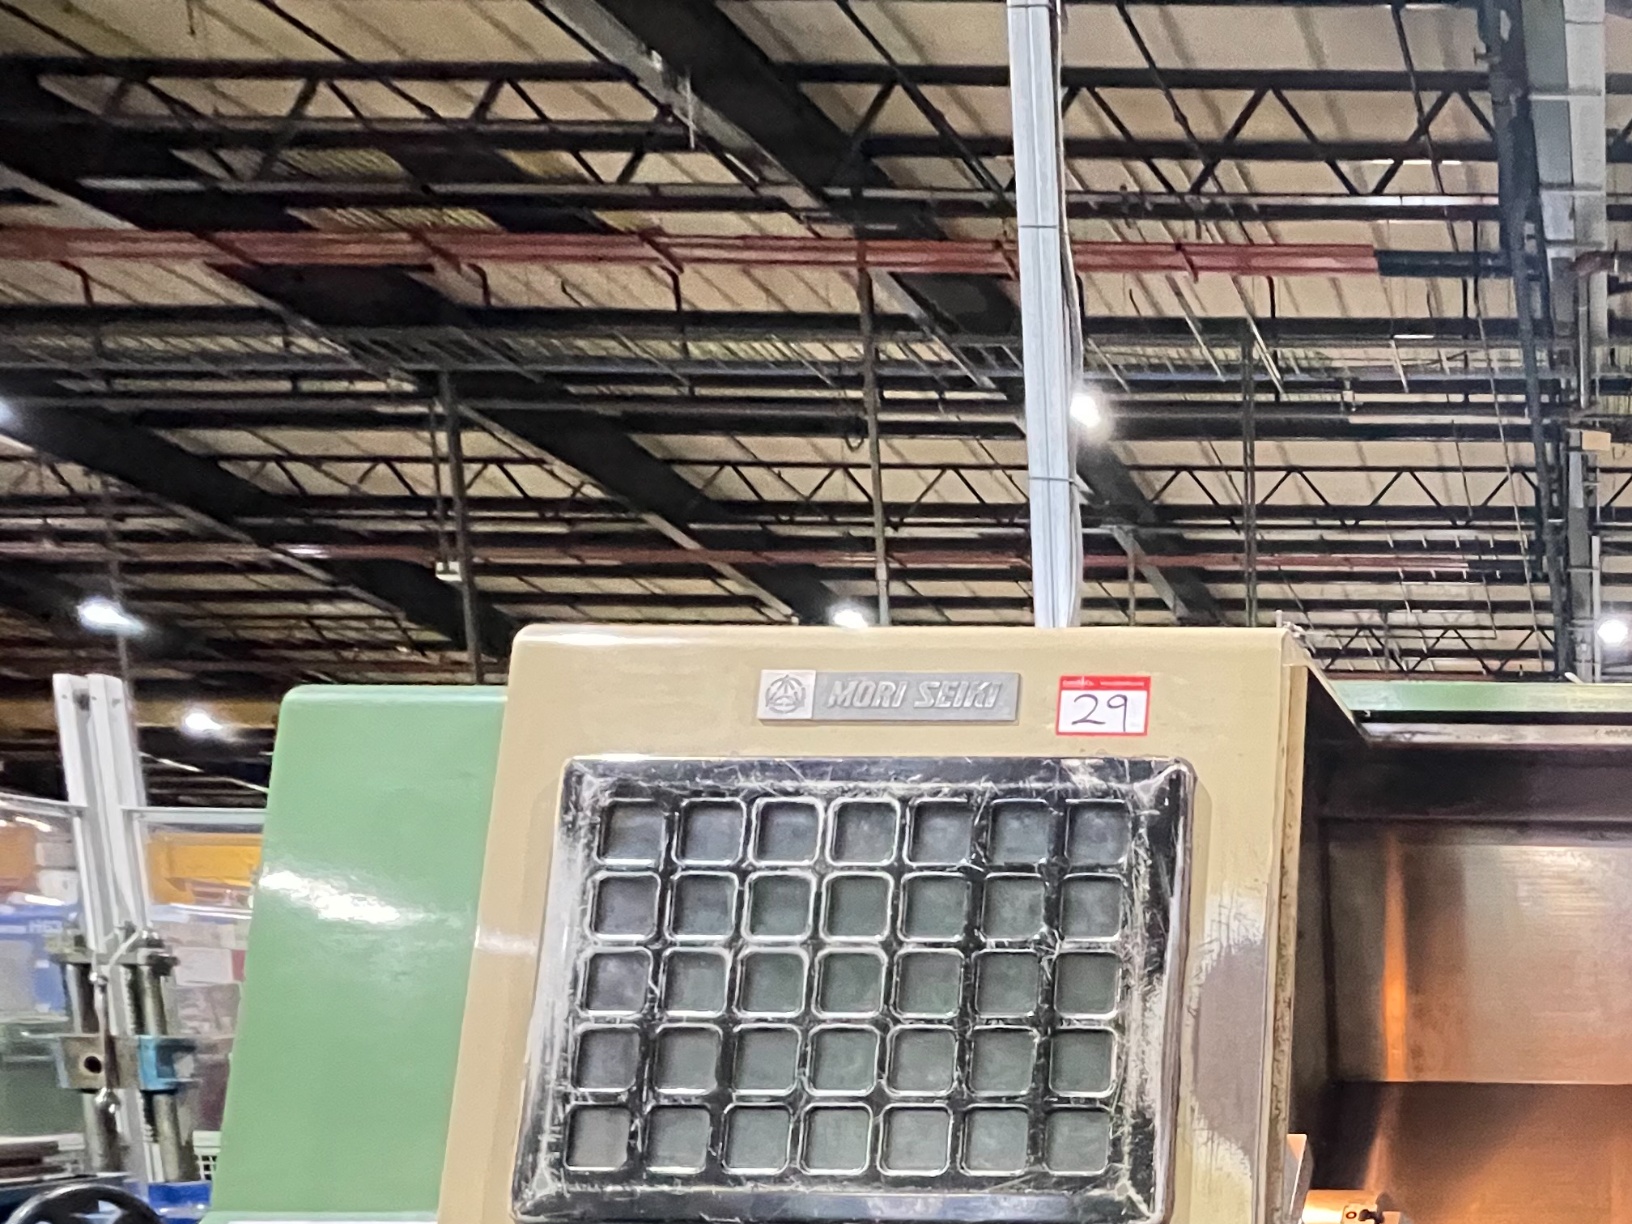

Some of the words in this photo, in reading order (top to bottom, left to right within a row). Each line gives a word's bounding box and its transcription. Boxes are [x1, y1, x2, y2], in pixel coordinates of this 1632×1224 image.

[827, 679, 908, 709] MORI
[913, 680, 1002, 709] SEIKI
[1071, 693, 1129, 733] 29
